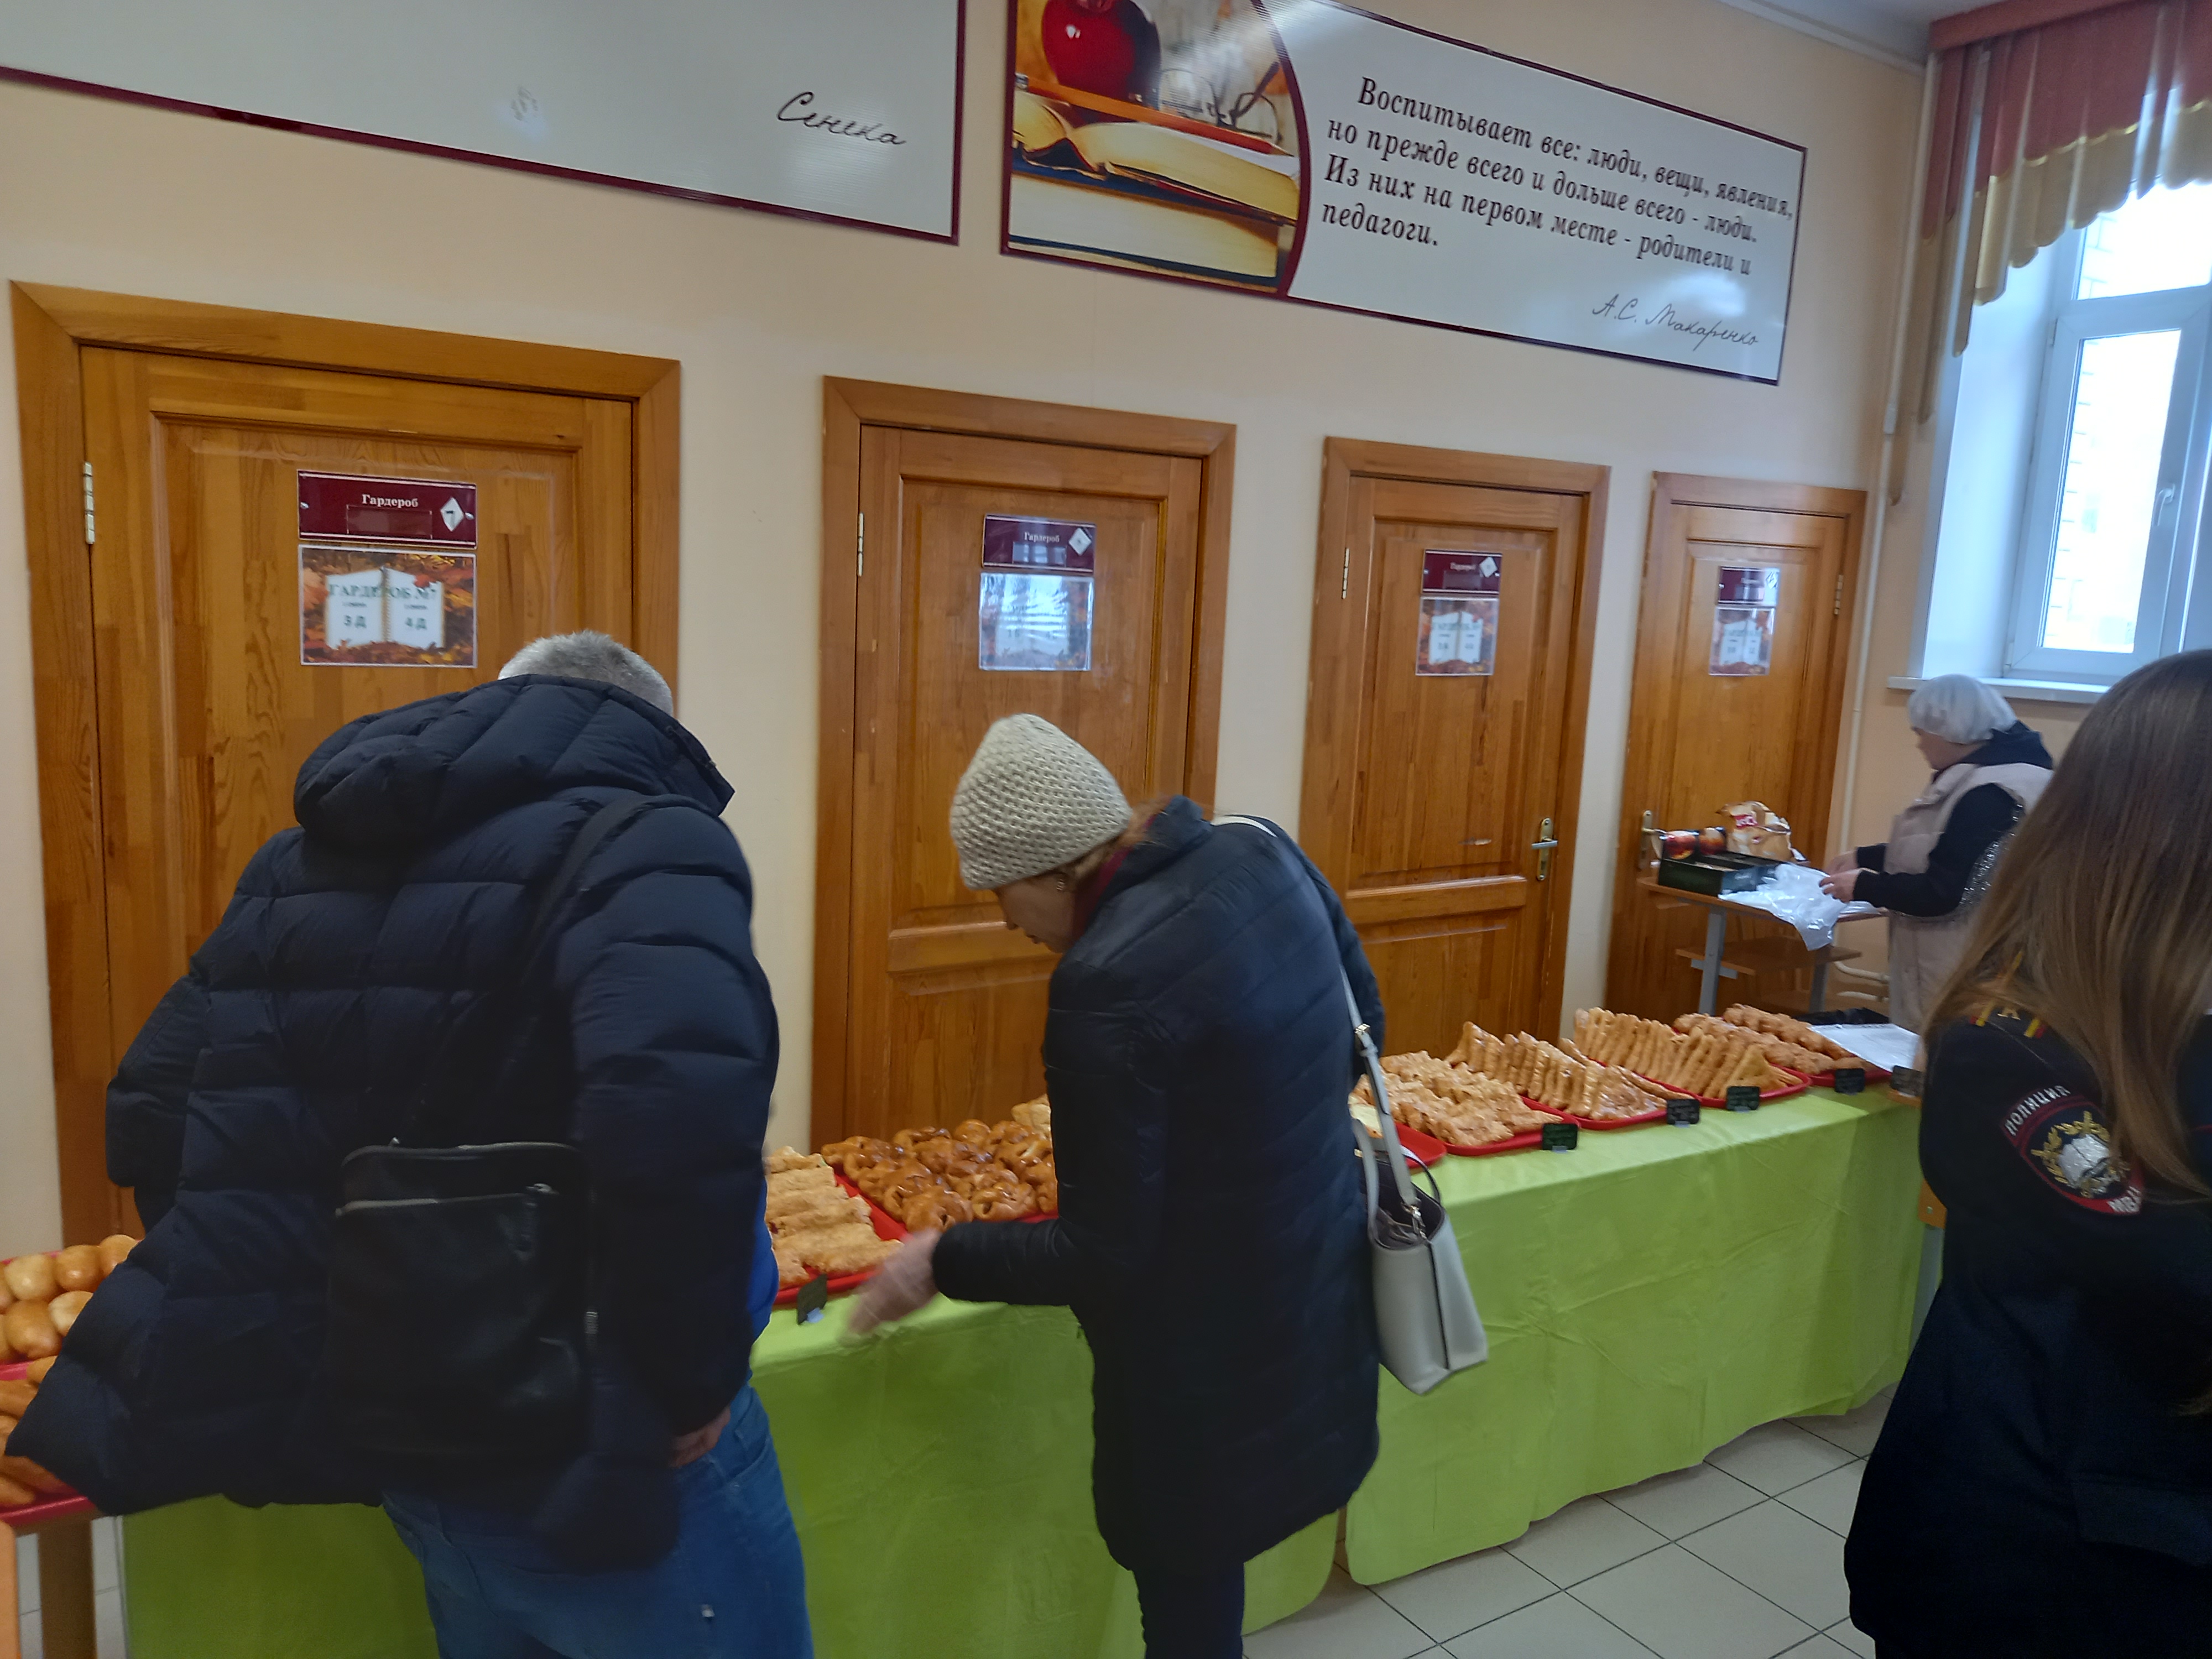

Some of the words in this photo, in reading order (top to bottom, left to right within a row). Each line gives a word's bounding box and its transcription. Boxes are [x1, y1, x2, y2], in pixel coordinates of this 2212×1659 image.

[776, 91, 907, 145] Сенека
[1358, 76, 1532, 148] Воспитывает
[1541, 135, 1581, 161] все:
[1587, 149, 1647, 182] люди,
[1654, 166, 1710, 198] вещи,
[1715, 182, 1793, 220] явления,
[1328, 119, 1358, 144] но
[1366, 129, 1459, 169] прежде
[1467, 156, 1524, 185] всего
[1532, 171, 1545, 191] и
[1553, 170, 1629, 211] дольше
[1635, 198, 1686, 225] всего
[1704, 214, 1757, 242] люди.
[1322, 203, 1438, 246] педагоги.
[1324, 153, 1359, 187] Из
[1369, 172, 1416, 200] них
[1423, 184, 1452, 208] на
[1462, 194, 1543, 229] первом
[1551, 215, 1618, 246] месте
[1635, 234, 1734, 272] родители
[1740, 258, 1751, 275] и
[1645, 303, 1759, 352] Макаренко
[362, 494, 419, 508] Гардероб
[1024, 532, 1060, 543] Гардероб
[2004, 1084, 2071, 1136] ПОЛИЦИЯ
